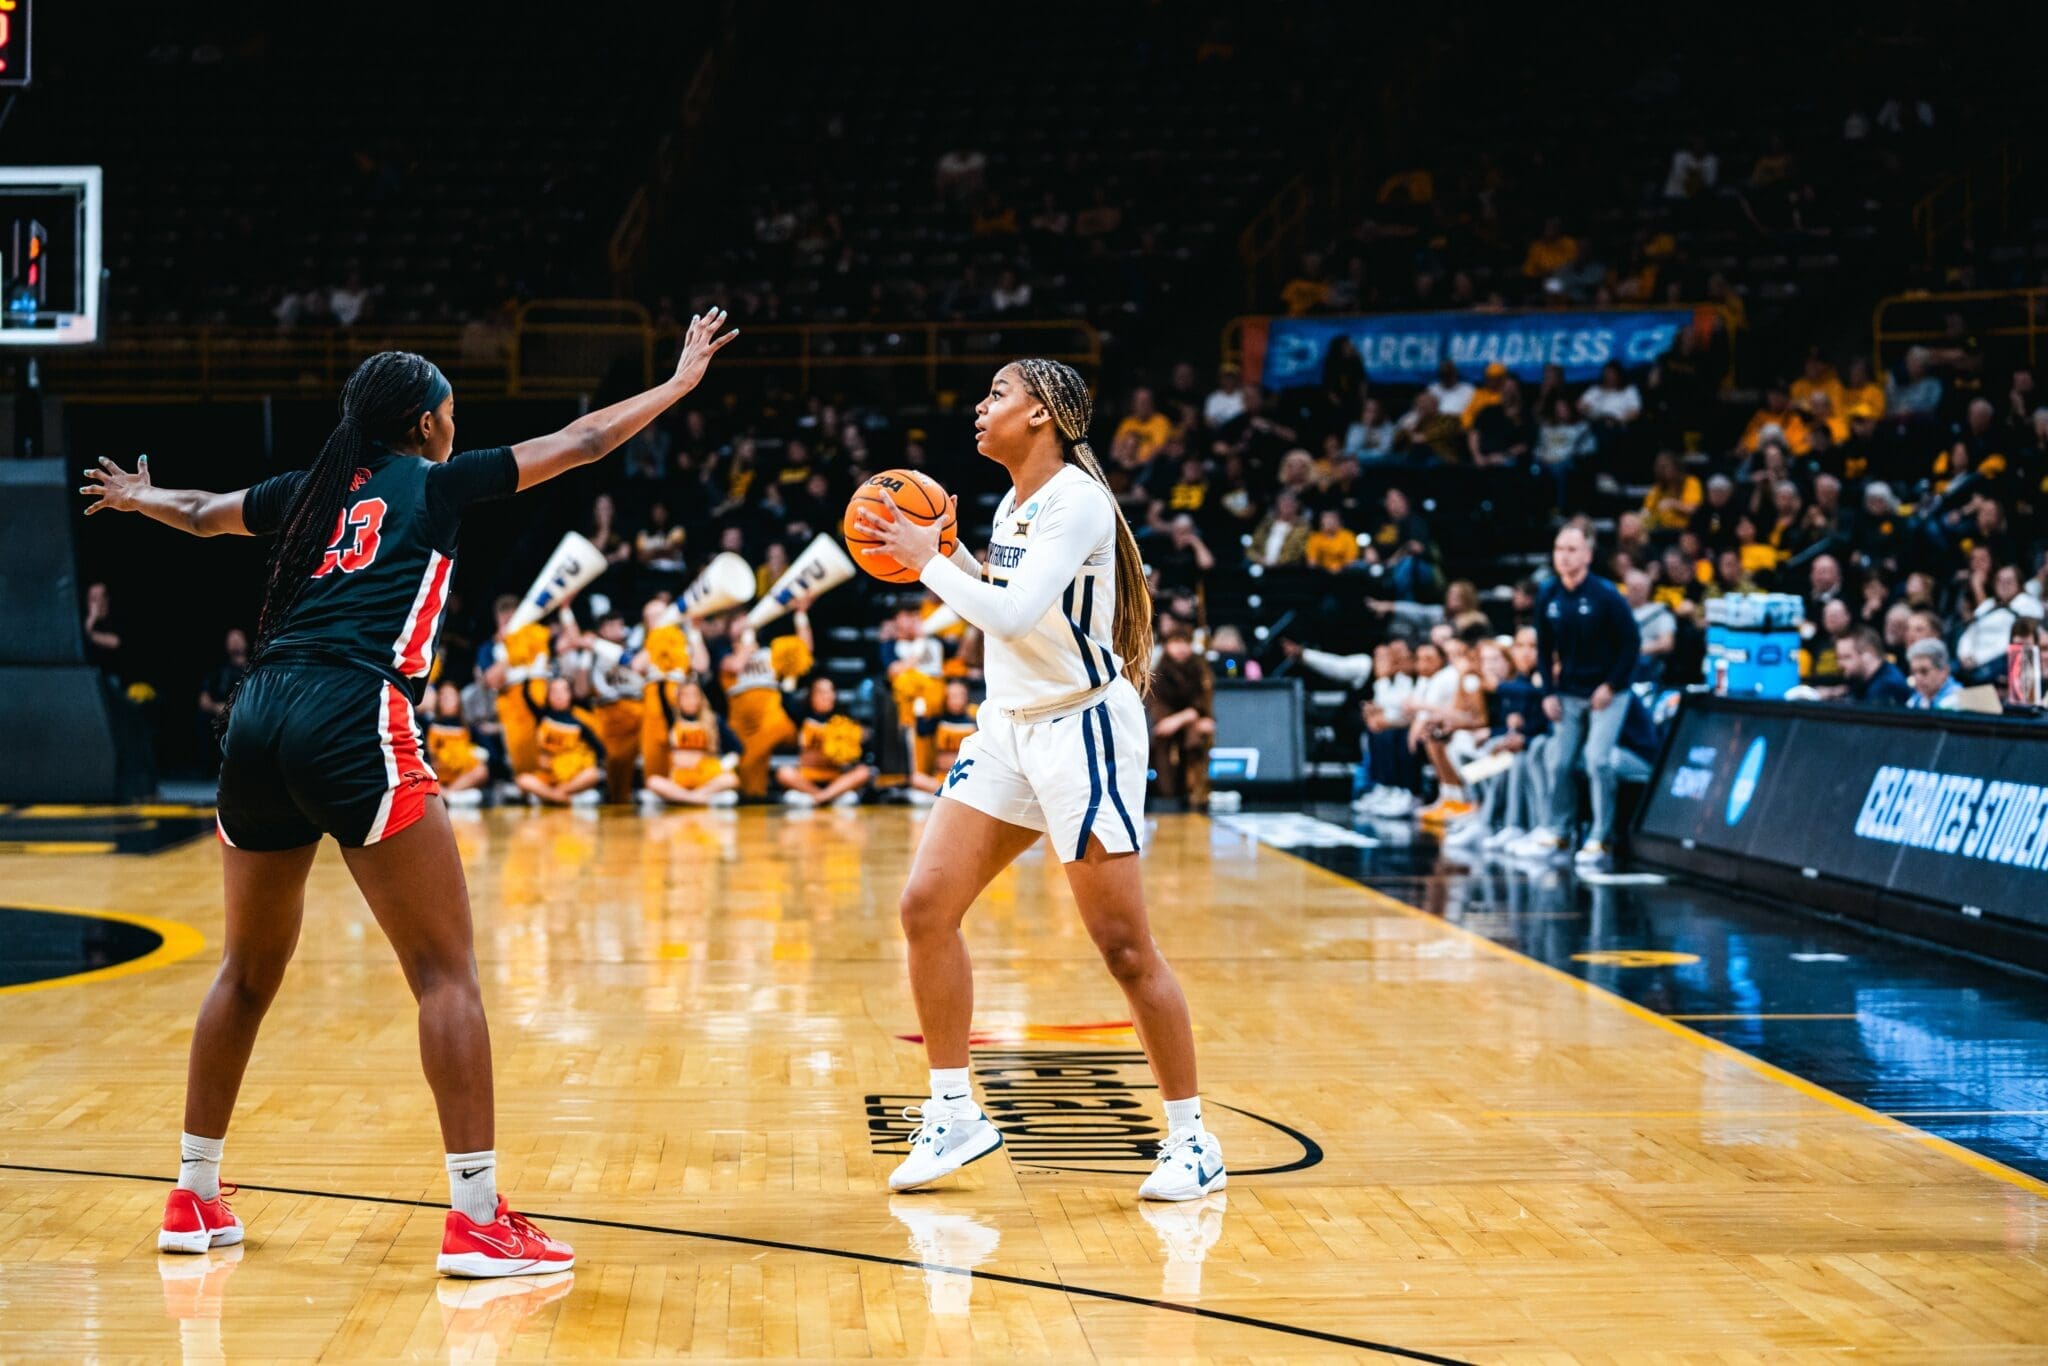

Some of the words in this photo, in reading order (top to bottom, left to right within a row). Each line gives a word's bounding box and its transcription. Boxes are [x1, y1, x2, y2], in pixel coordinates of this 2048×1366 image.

[1361, 335, 1439, 368] ARCH
[1450, 330, 1612, 364] MADNESS
[1855, 766, 1984, 853] CELEBRATES
[1961, 781, 2048, 871] STUDEN
